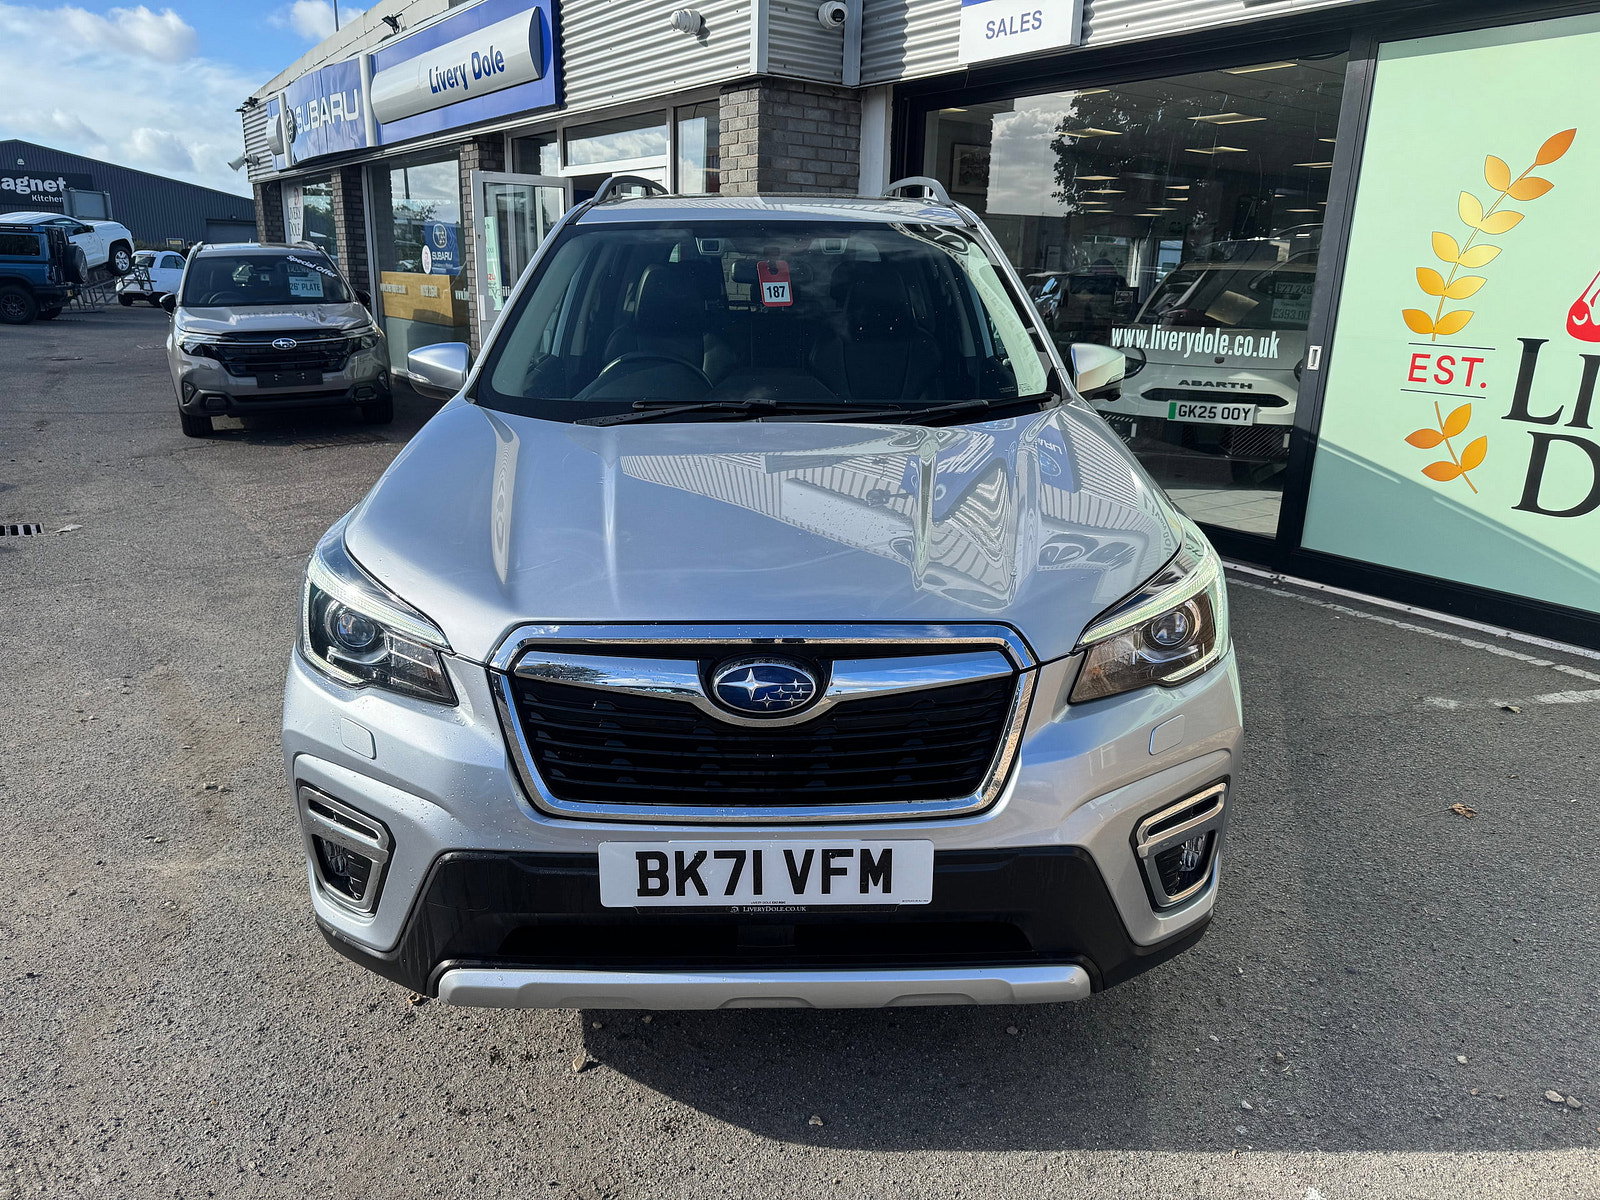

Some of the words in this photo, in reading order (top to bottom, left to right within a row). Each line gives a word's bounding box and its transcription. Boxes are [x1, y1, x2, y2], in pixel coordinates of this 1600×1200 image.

[985, 9, 1043, 40] SALES
[428, 62, 469, 94] Livery
[471, 44, 505, 81] Dole
[294, 88, 360, 135] SUBARU
[0, 176, 66, 195] agnet
[286, 254, 317, 269] Special
[315, 265, 338, 279] Offer
[431, 251, 453, 261] SUBARU
[301, 282, 321, 292] PLATE
[766, 285, 786, 299] 187
[1111, 323, 1281, 360] www.liverydole.co.uk
[1407, 352, 1488, 390] EST.
[1178, 379, 1253, 390] ABARTH
[1178, 404, 1218, 420] GK25
[635, 849, 764, 897] BK71
[782, 848, 893, 895] VFM
